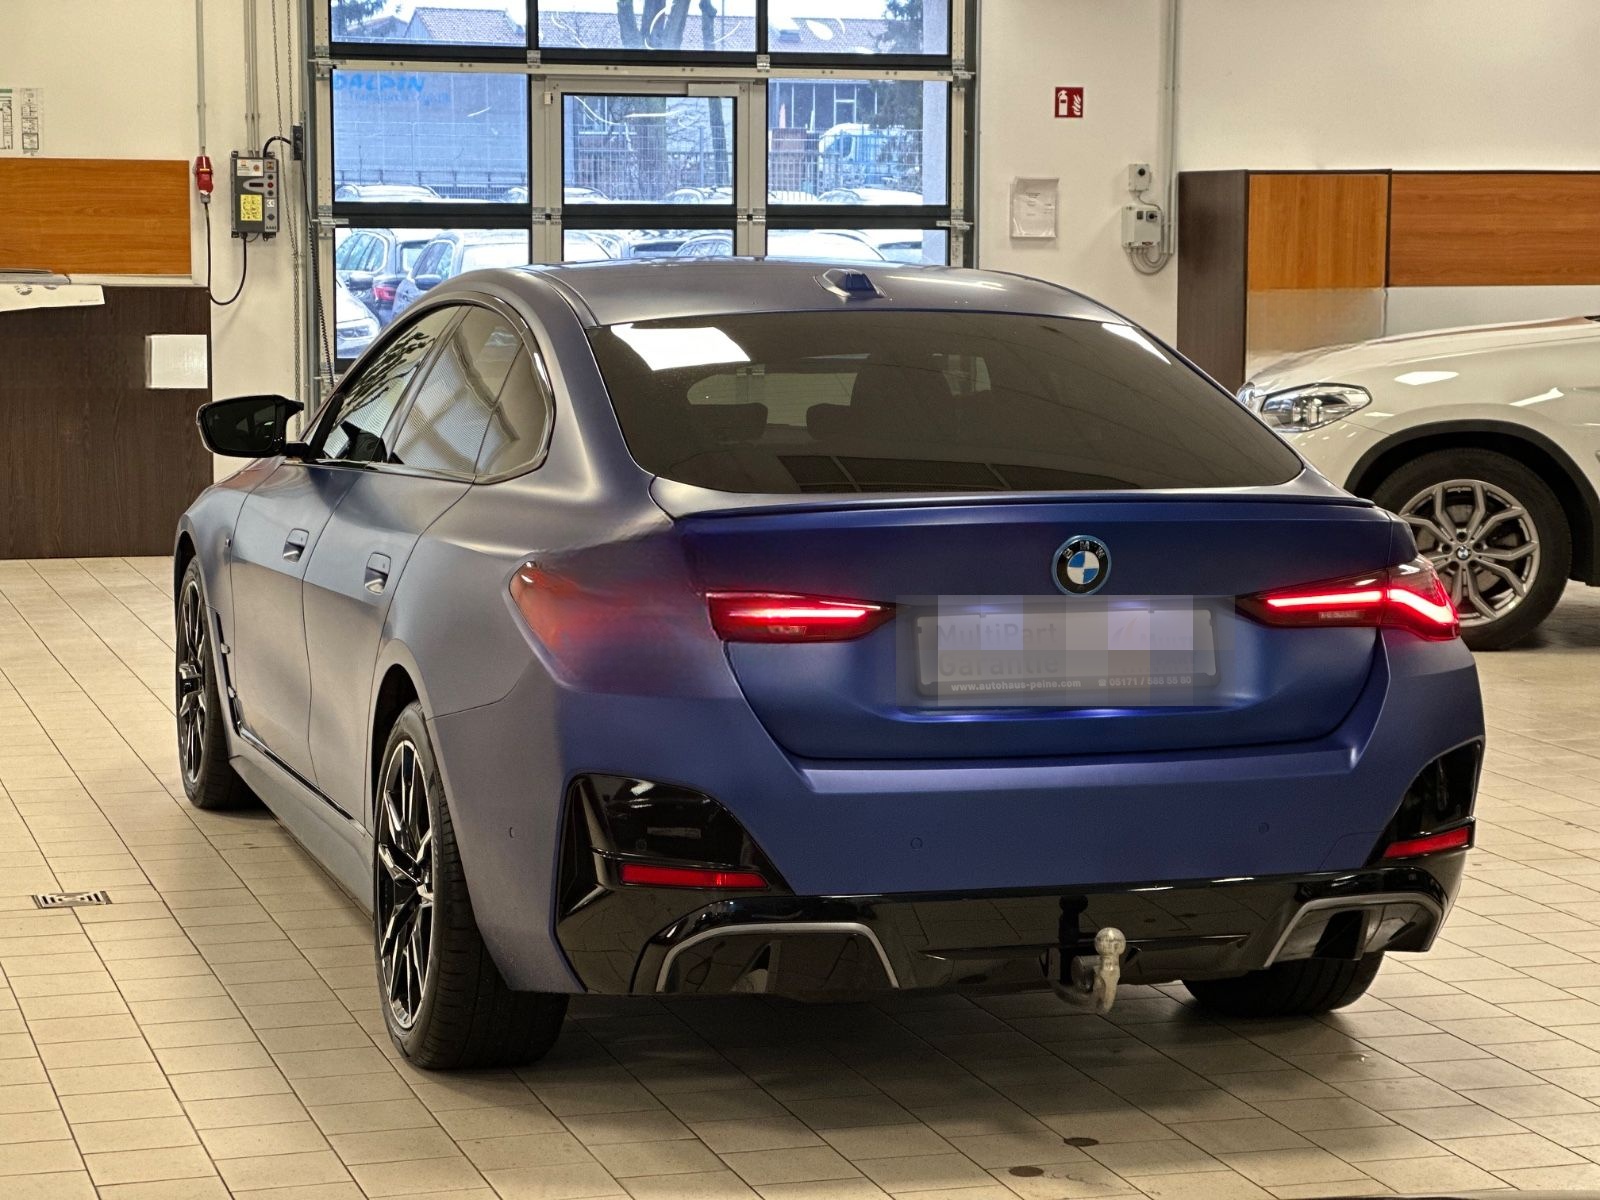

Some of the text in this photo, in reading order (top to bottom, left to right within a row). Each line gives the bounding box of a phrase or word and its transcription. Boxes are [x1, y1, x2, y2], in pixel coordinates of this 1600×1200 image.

[1063, 540, 1105, 559] BMW
[950, 679, 1081, 691] www.autohaus-peine.com
[1108, 677, 1138, 686] 05171
